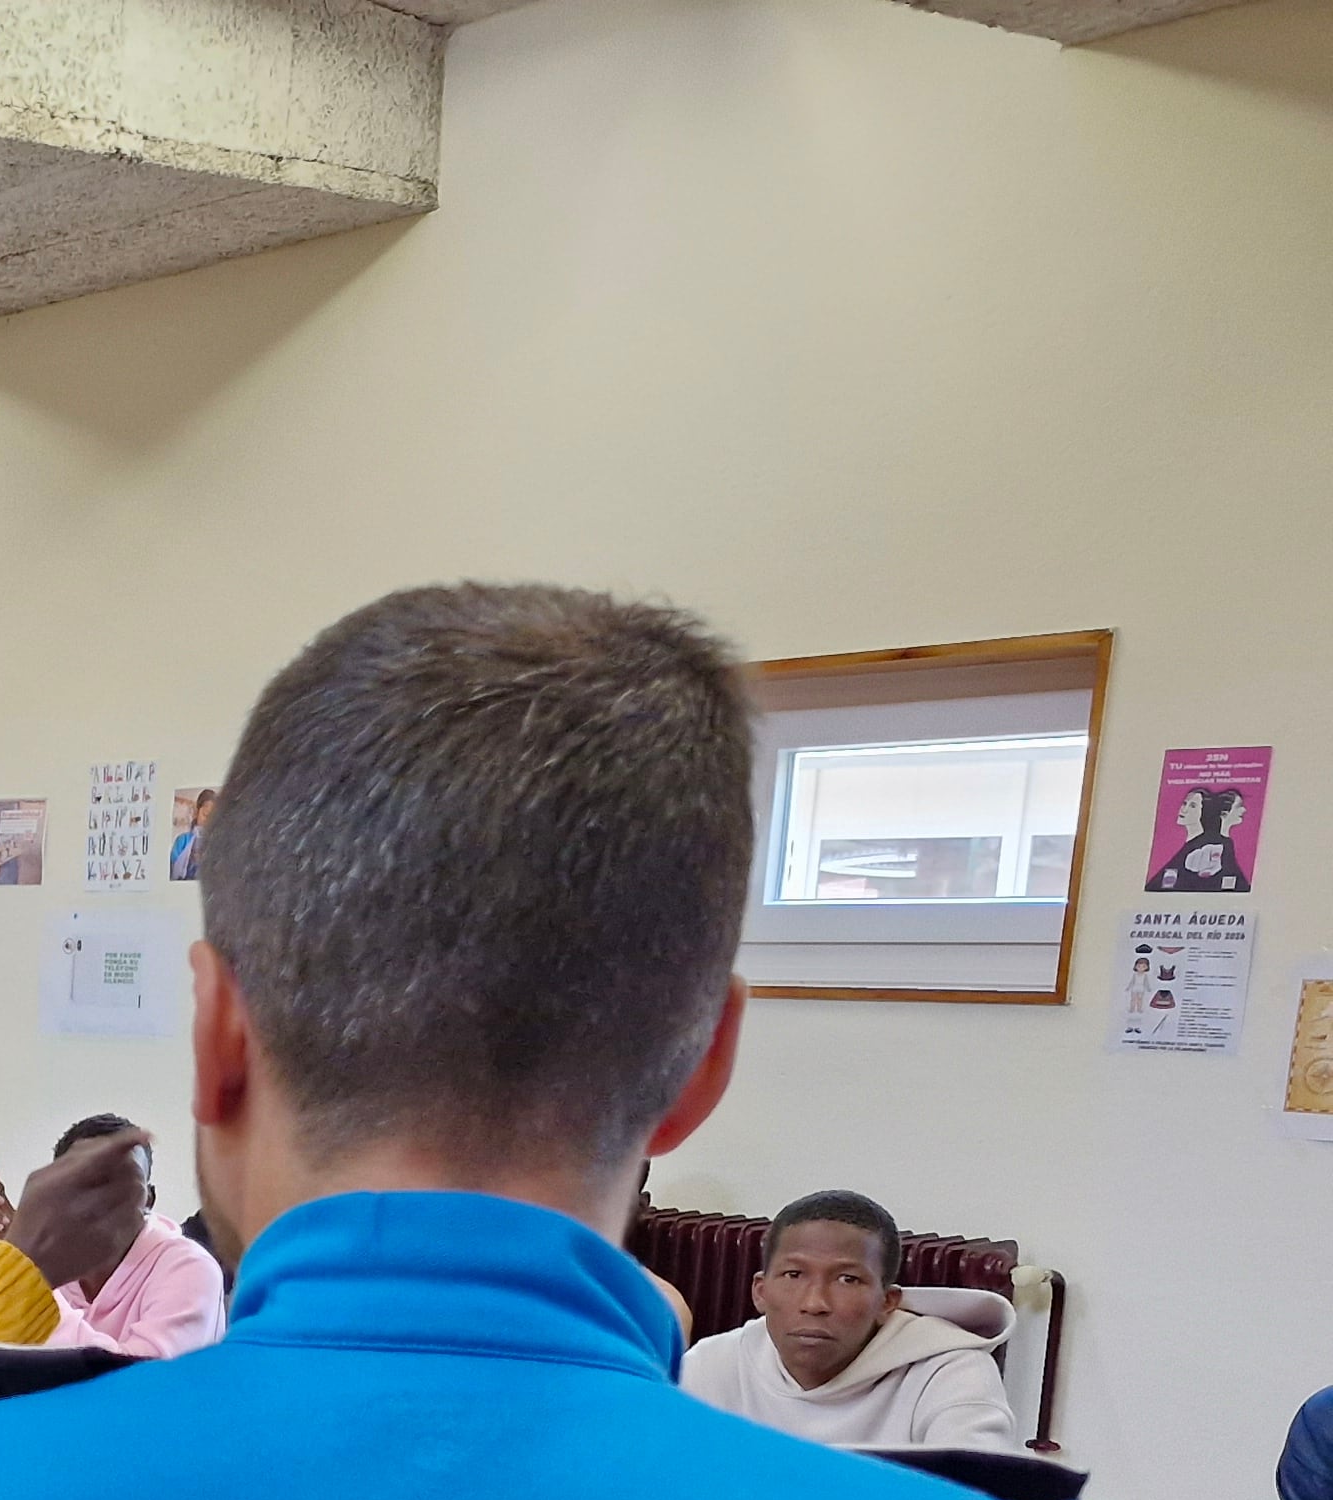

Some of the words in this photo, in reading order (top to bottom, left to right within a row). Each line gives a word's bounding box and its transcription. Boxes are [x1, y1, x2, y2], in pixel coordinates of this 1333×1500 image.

[1134, 913, 1181, 925] SANTA
[1188, 911, 1245, 926] ÁGUEDA
[1130, 930, 1183, 939] CARRASCAL
[1186, 931, 1204, 940] DEL
[1206, 929, 1221, 940] RÍO
